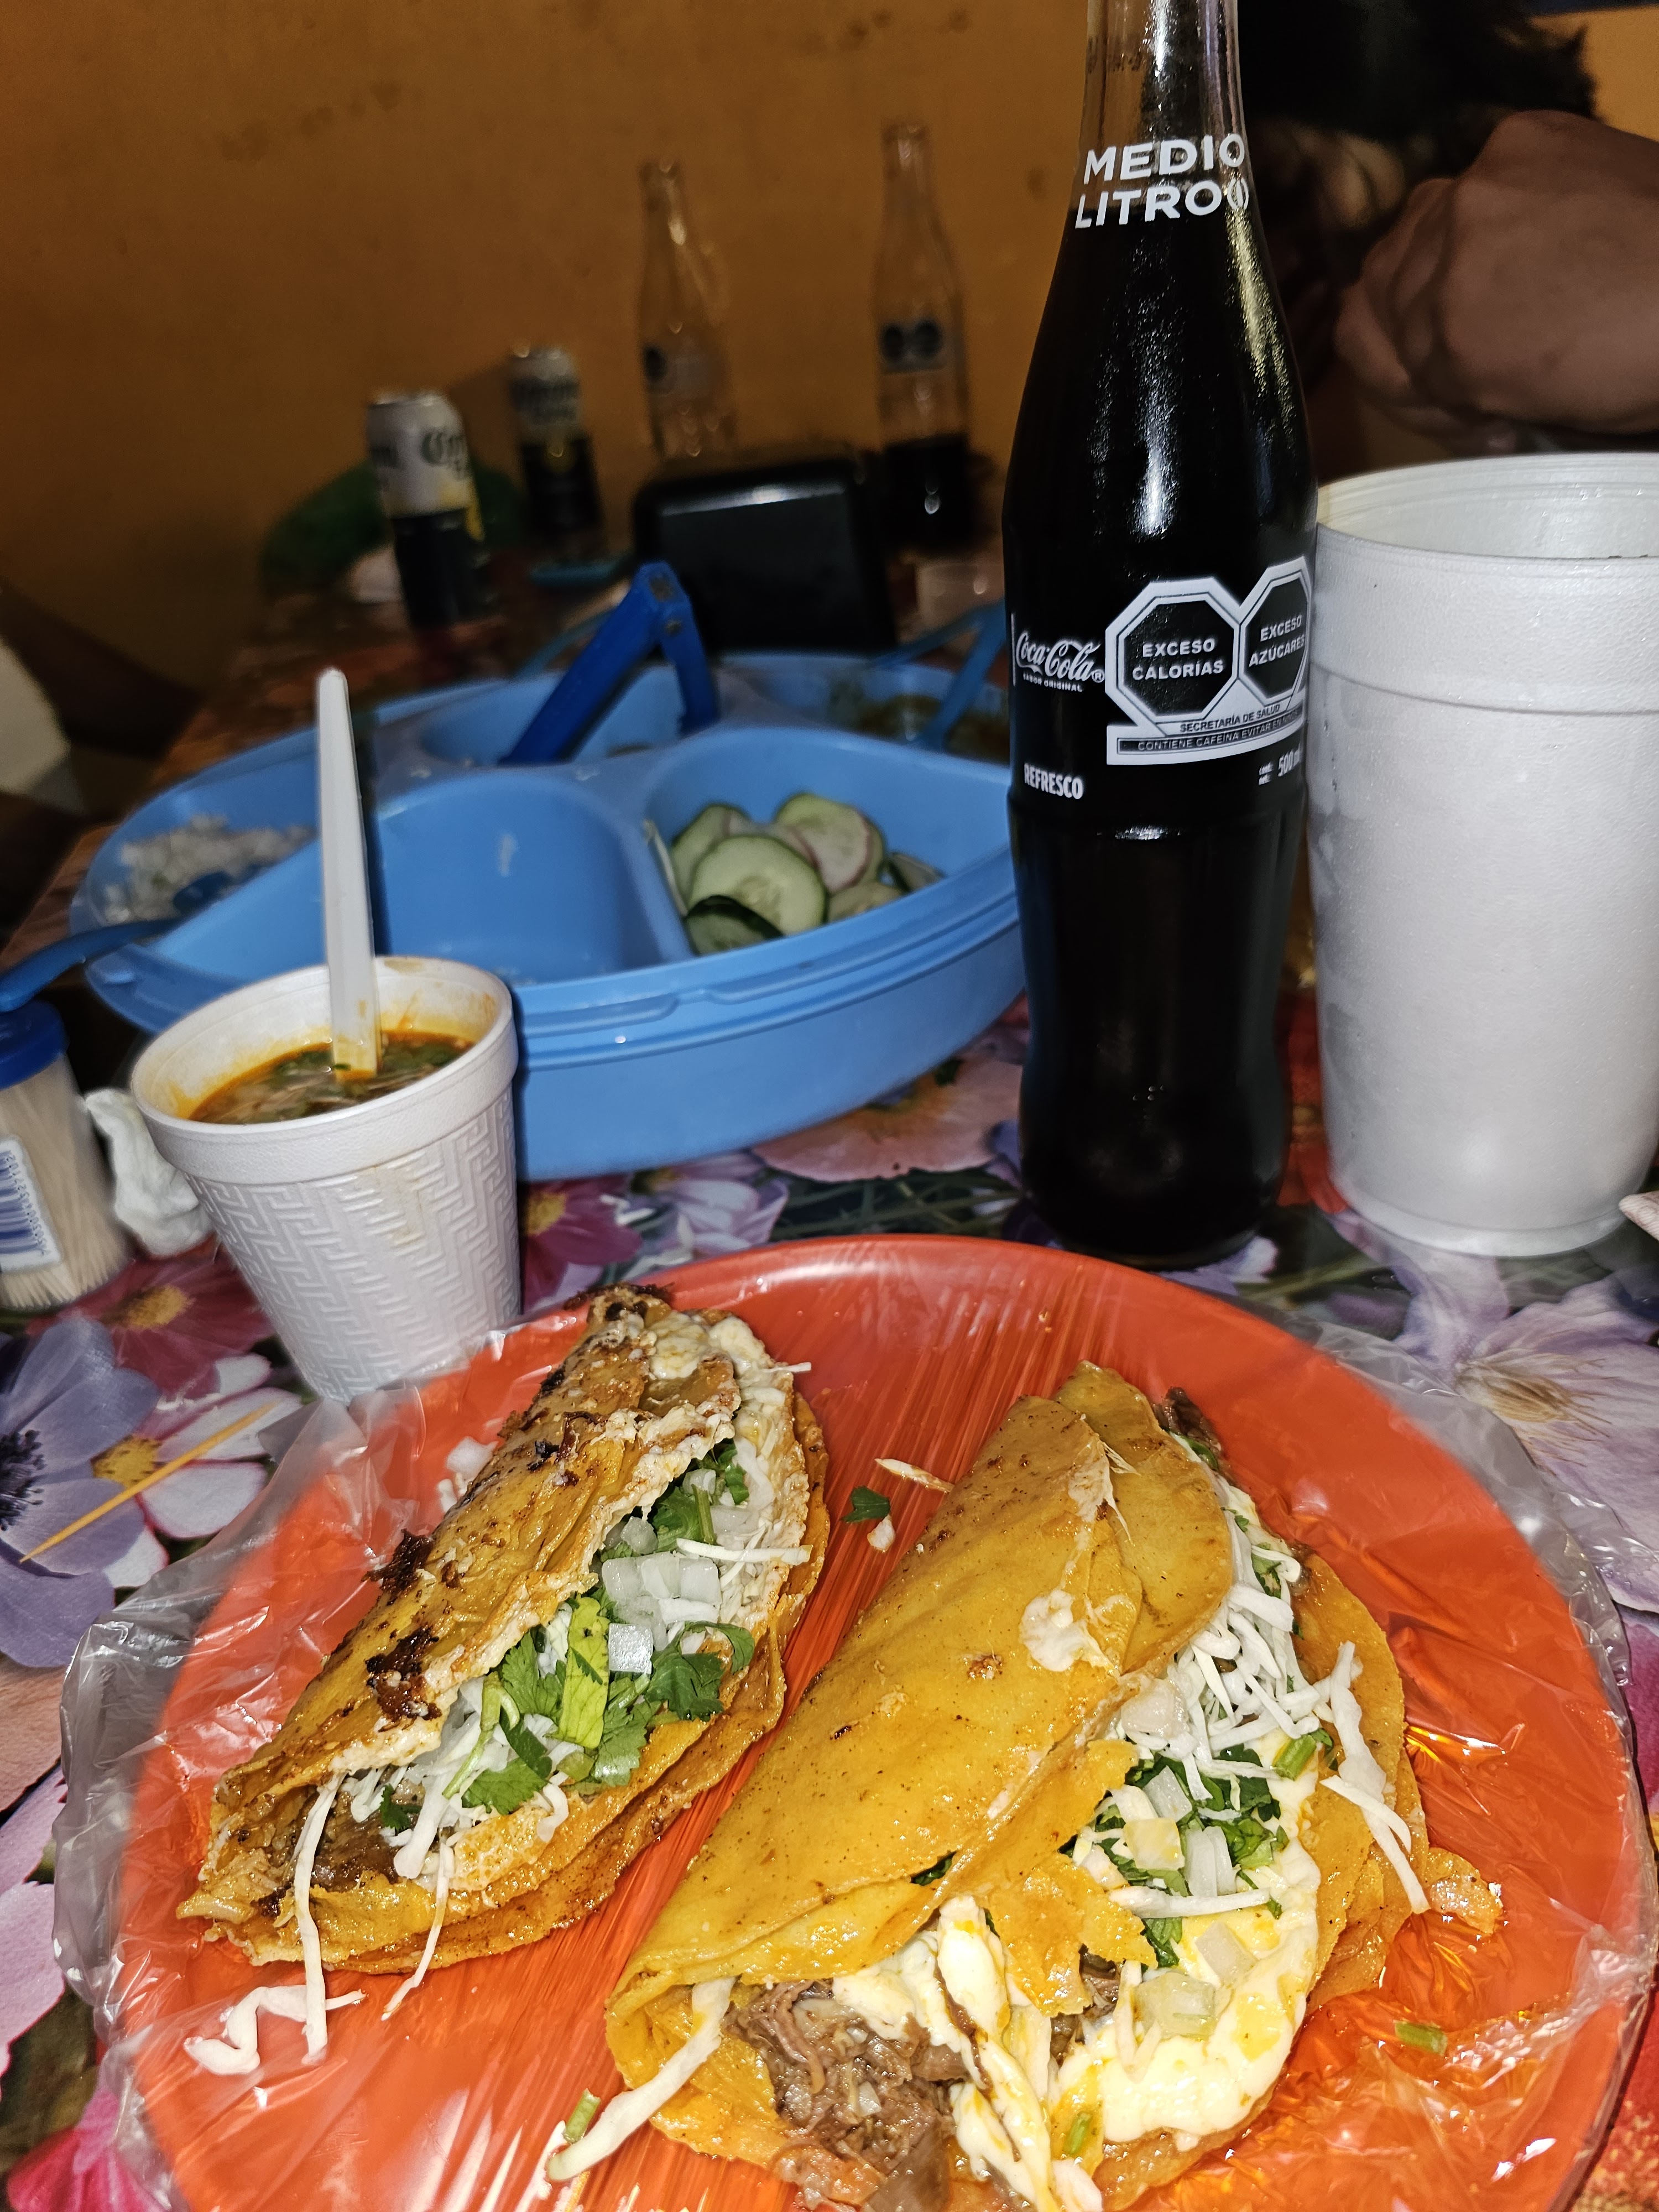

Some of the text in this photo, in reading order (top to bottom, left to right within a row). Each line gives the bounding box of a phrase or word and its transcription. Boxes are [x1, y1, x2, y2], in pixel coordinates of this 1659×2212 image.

[1083, 133, 1245, 185] MEDIO
[1260, 614, 1302, 642] EXCESO
[1142, 638, 1216, 658] EXCESO
[1249, 634, 1305, 667] AZÚCARES
[1133, 659, 1224, 680] CALORÍAS
[1044, 679, 1083, 692] ORIGINAL
[1243, 712, 1255, 723] DE
[1256, 704, 1281, 719] SALUD
[1138, 738, 1193, 751] CONTIENE
[1241, 722, 1271, 738] EVITAR
[1024, 763, 1083, 800] REFRESCO
